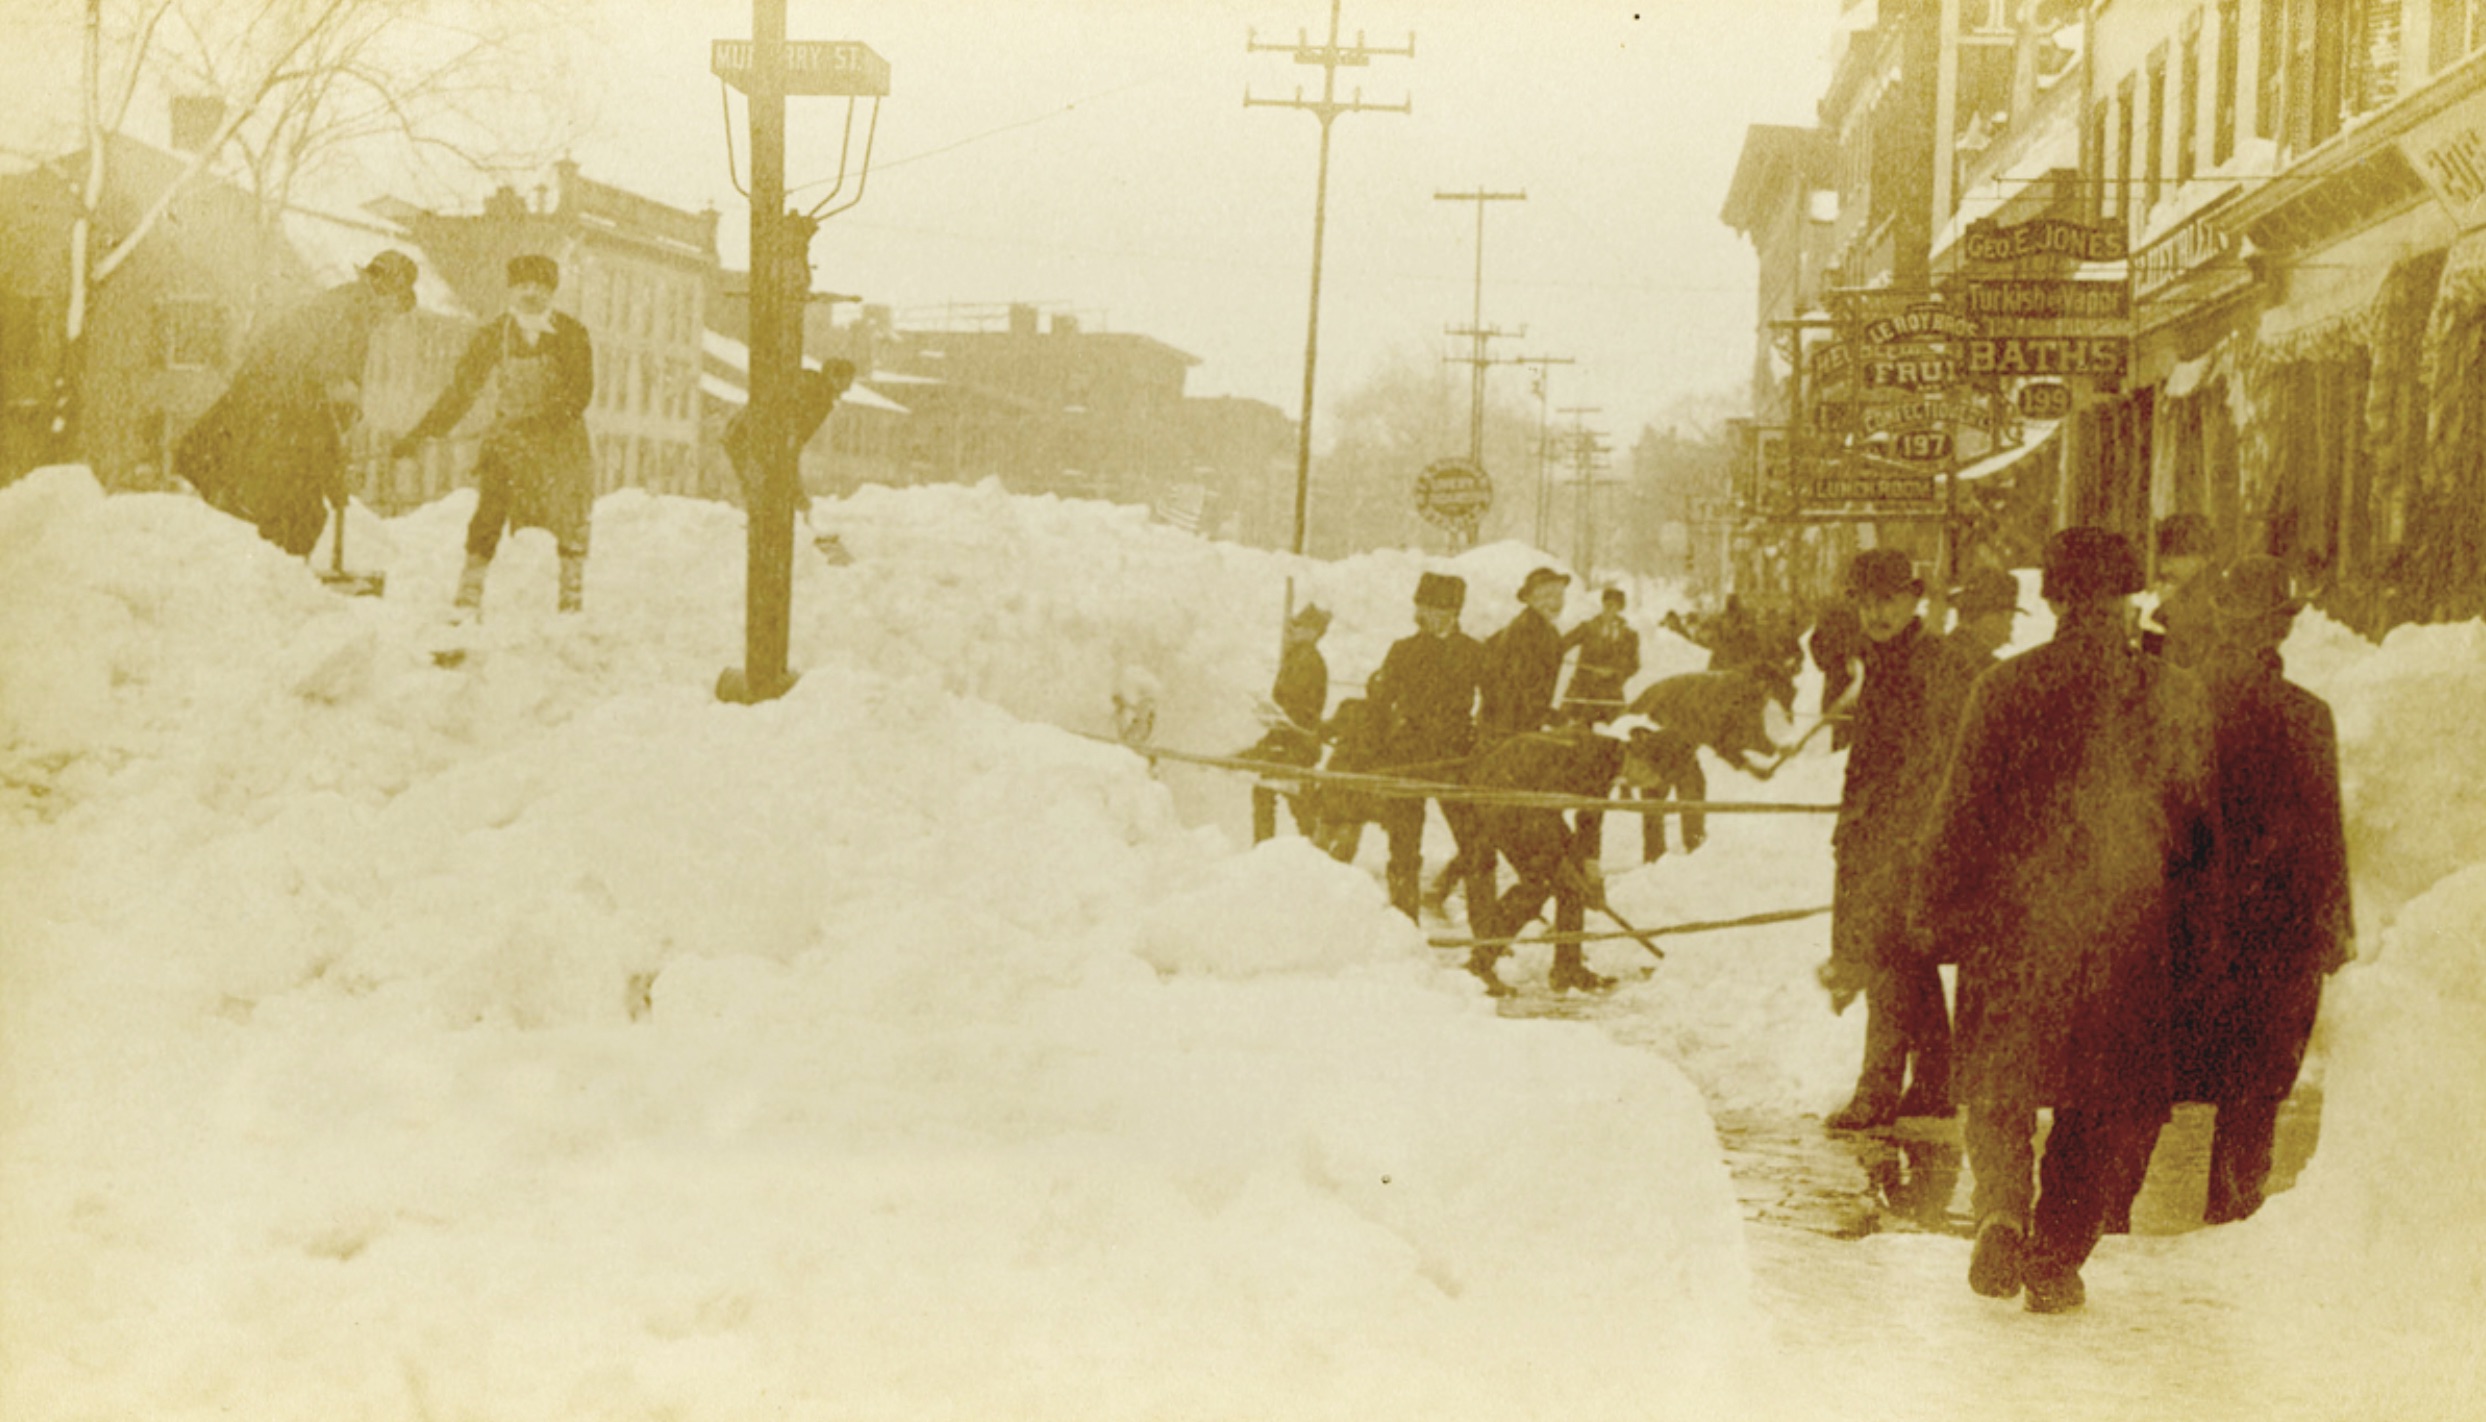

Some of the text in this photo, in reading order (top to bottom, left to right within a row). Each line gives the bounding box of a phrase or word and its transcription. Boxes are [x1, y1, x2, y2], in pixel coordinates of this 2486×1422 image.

[716, 44, 821, 71] MURRY
[2036, 223, 2122, 257] JONES
[1968, 284, 2044, 311] Turkish
[2062, 284, 2120, 316] Vapor
[1874, 361, 1960, 384] FRUI
[2024, 387, 2067, 413] 199
[1903, 434, 1945, 456] 197
